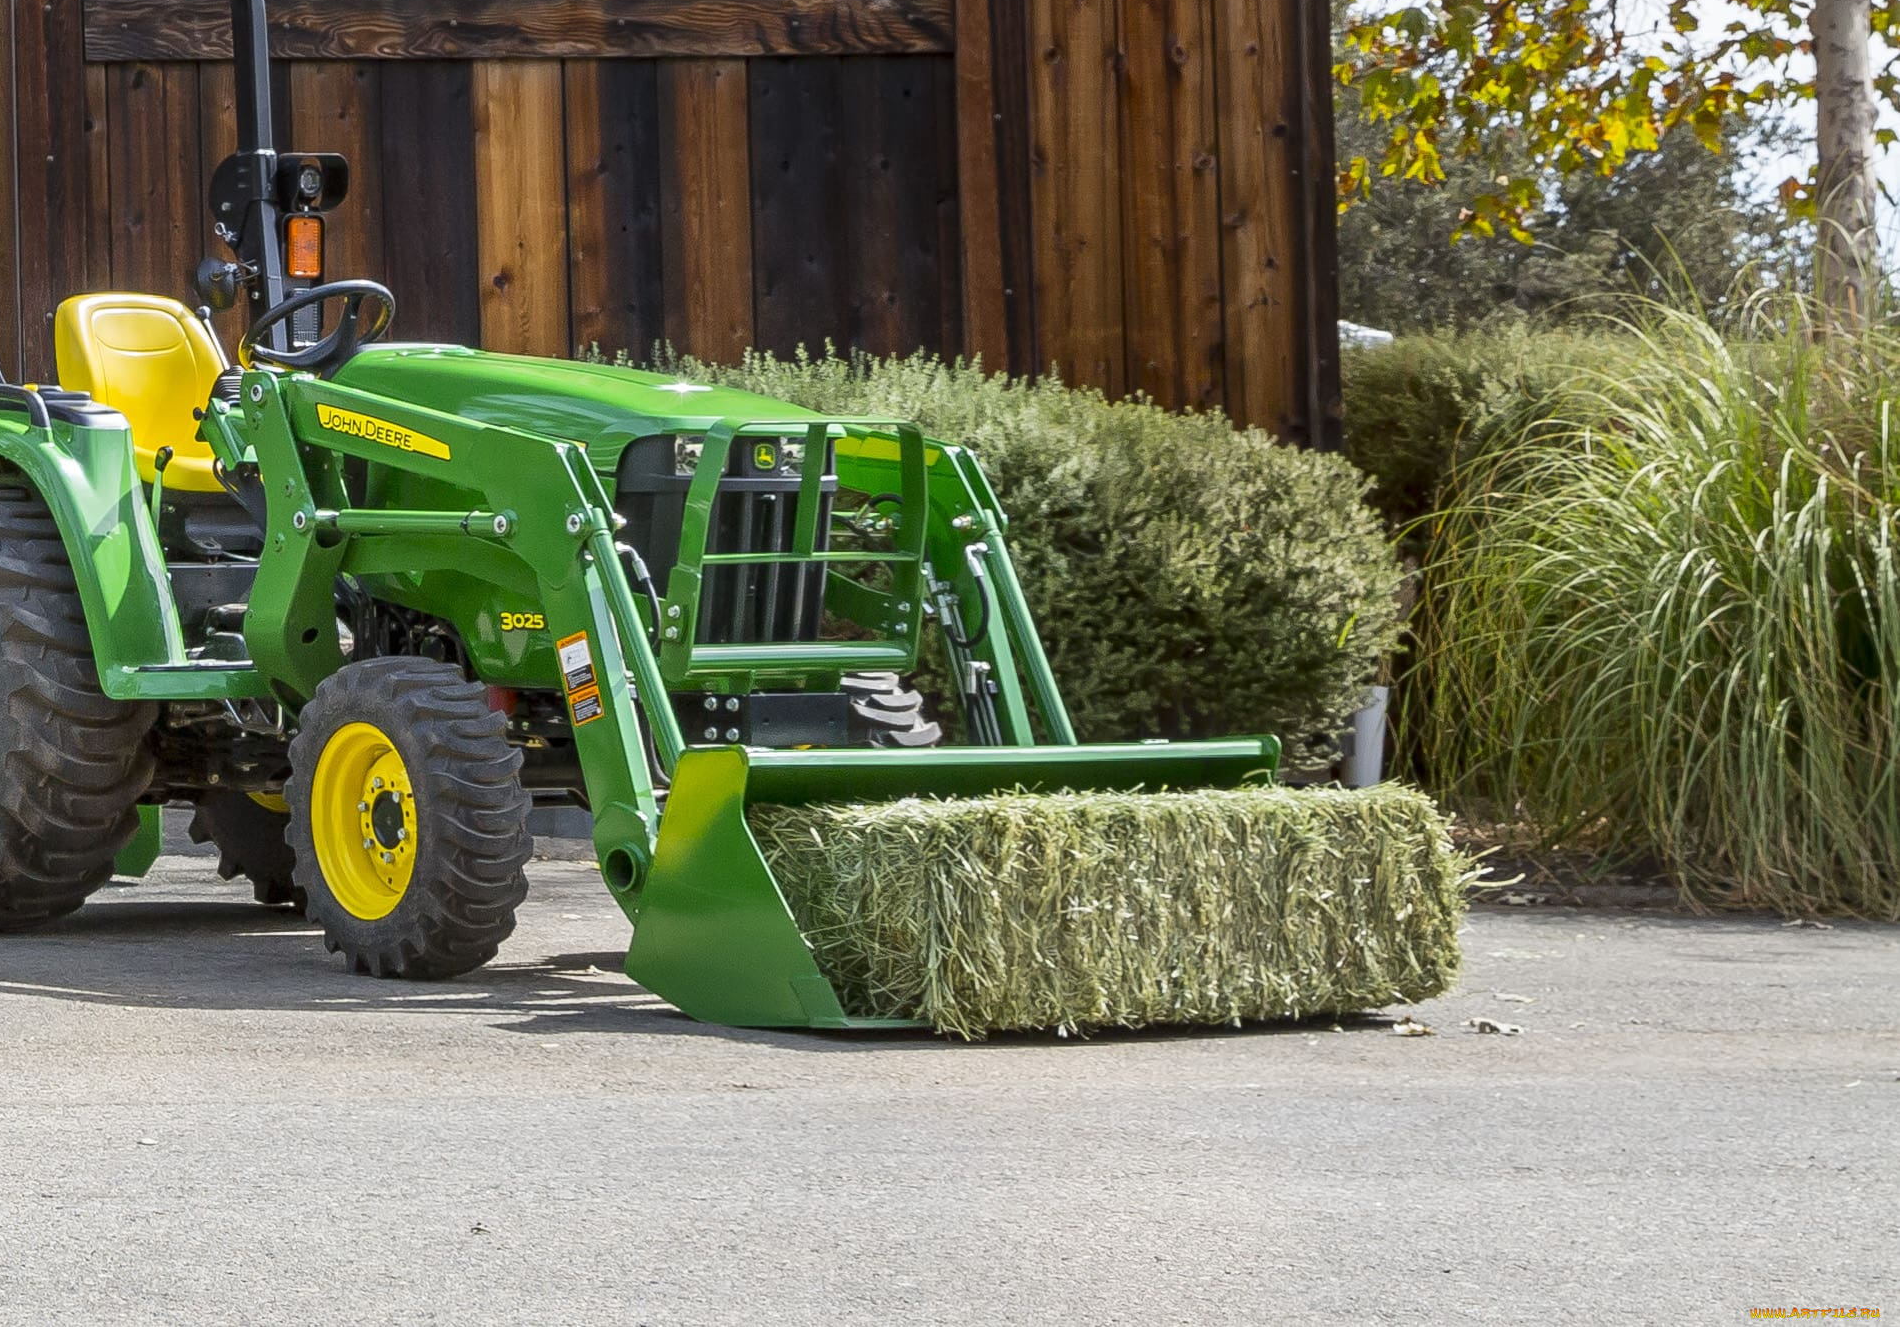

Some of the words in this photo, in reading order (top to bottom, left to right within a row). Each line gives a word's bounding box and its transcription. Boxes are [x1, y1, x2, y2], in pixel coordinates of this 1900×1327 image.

[323, 410, 362, 434] JOHN
[365, 421, 413, 448] DEERE
[500, 612, 545, 631] 3025
